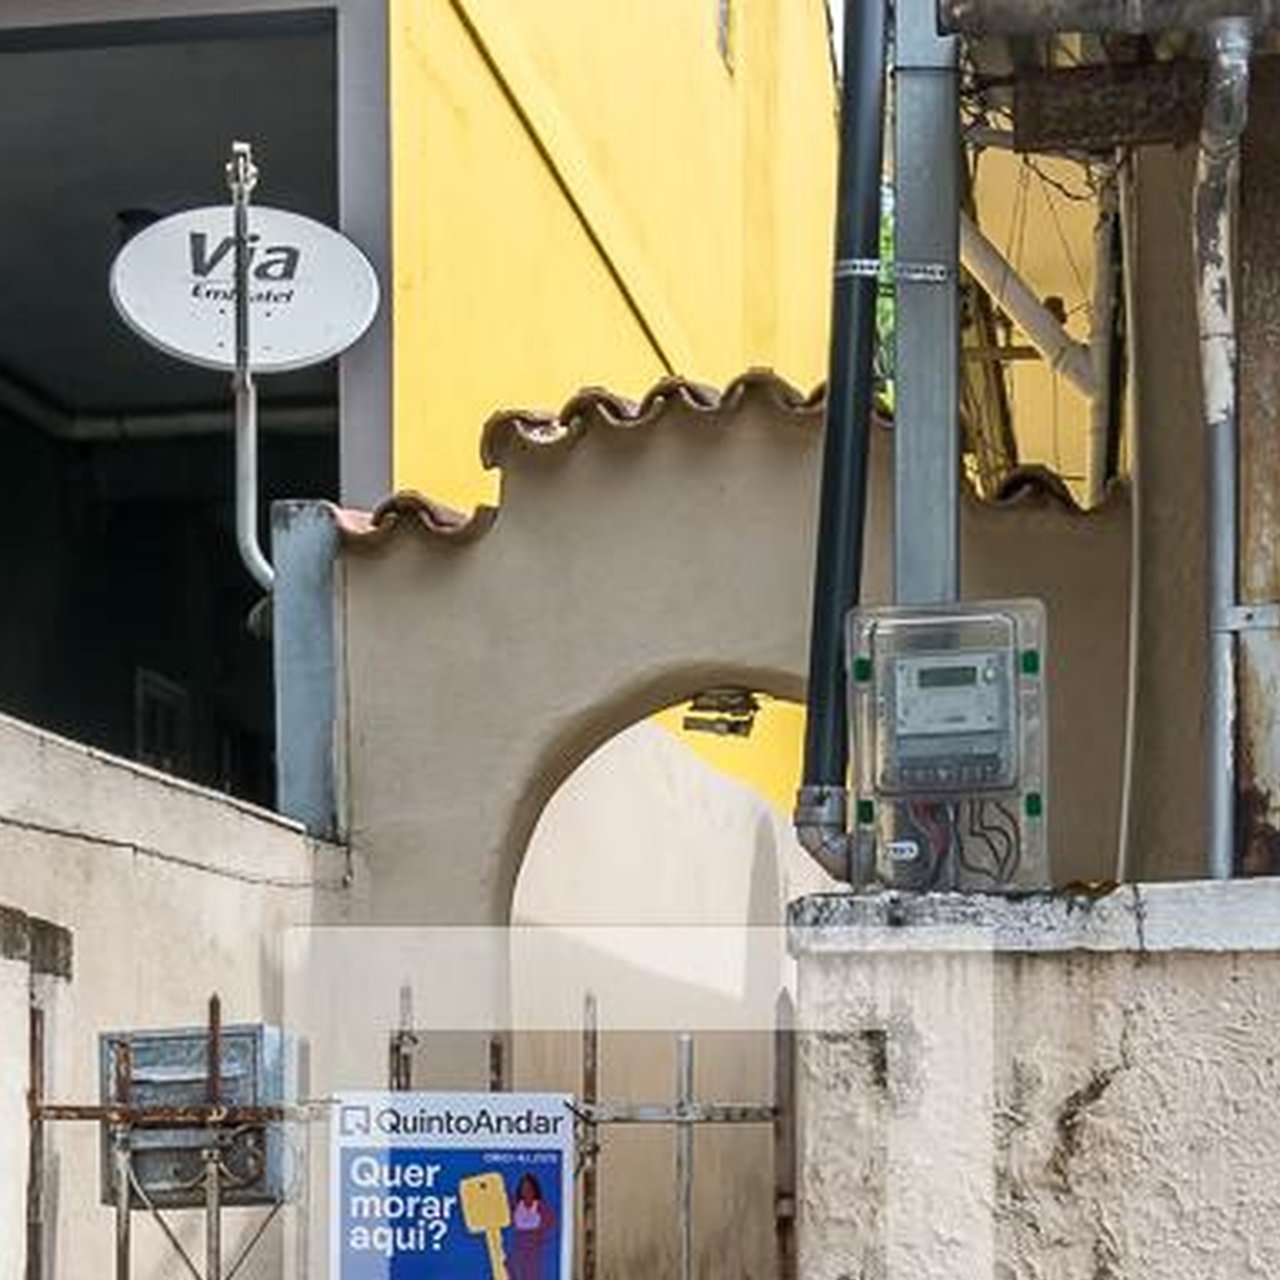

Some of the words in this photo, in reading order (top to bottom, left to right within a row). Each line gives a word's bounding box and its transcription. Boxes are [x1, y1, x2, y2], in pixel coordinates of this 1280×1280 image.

[189, 232, 300, 281] Via
[191, 283, 295, 304] Embatel
[377, 1108, 564, 1136] QuintoAndar
[350, 1156, 441, 1189] Quer
[350, 1195, 457, 1220] morar
[349, 1221, 448, 1255] aqui?
